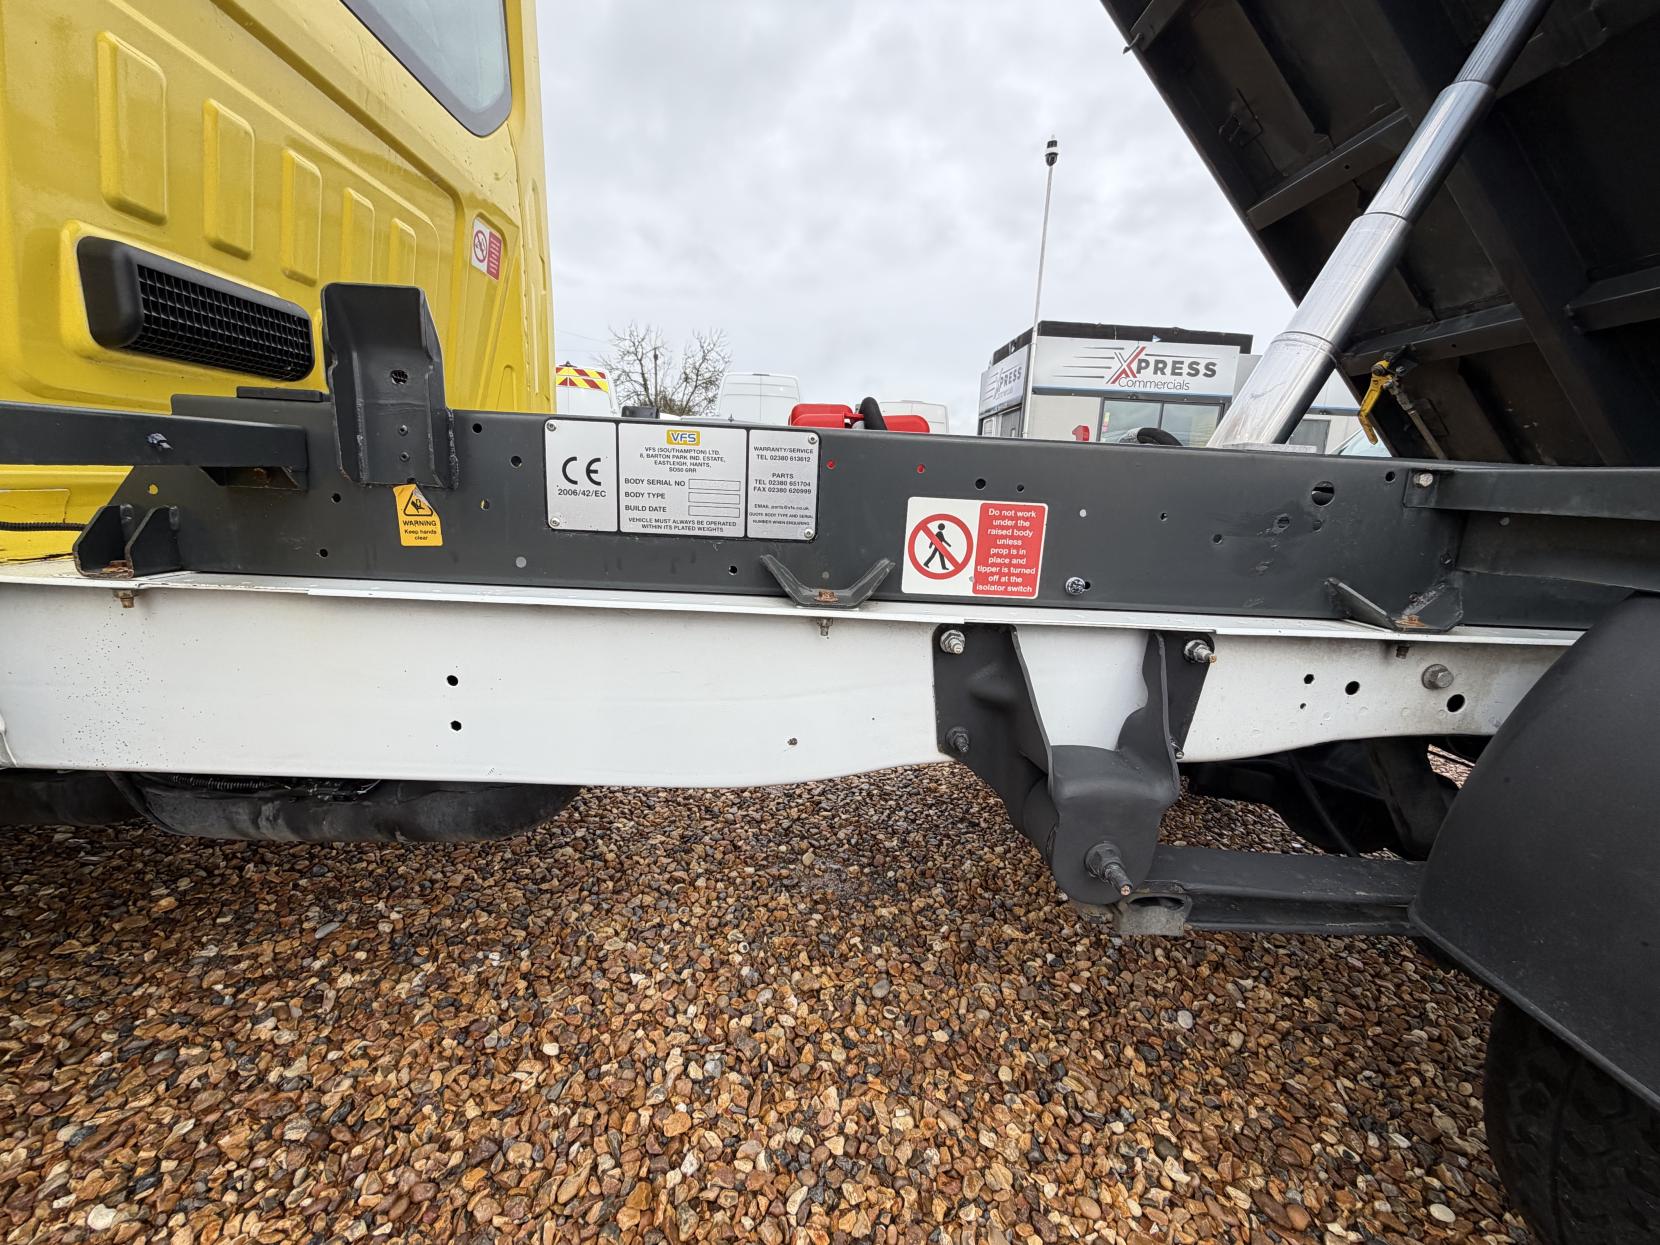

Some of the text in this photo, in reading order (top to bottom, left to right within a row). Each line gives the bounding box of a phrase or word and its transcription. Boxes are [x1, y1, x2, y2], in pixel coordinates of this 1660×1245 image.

[1106, 346, 1217, 384] XPRESS
[1118, 376, 1190, 390] Commercials
[671, 432, 696, 442] VFS
[658, 447, 708, 455] (SOUTHAMPTON)
[558, 488, 606, 498] 2006/42/EC
[1014, 529, 1033, 537] body
